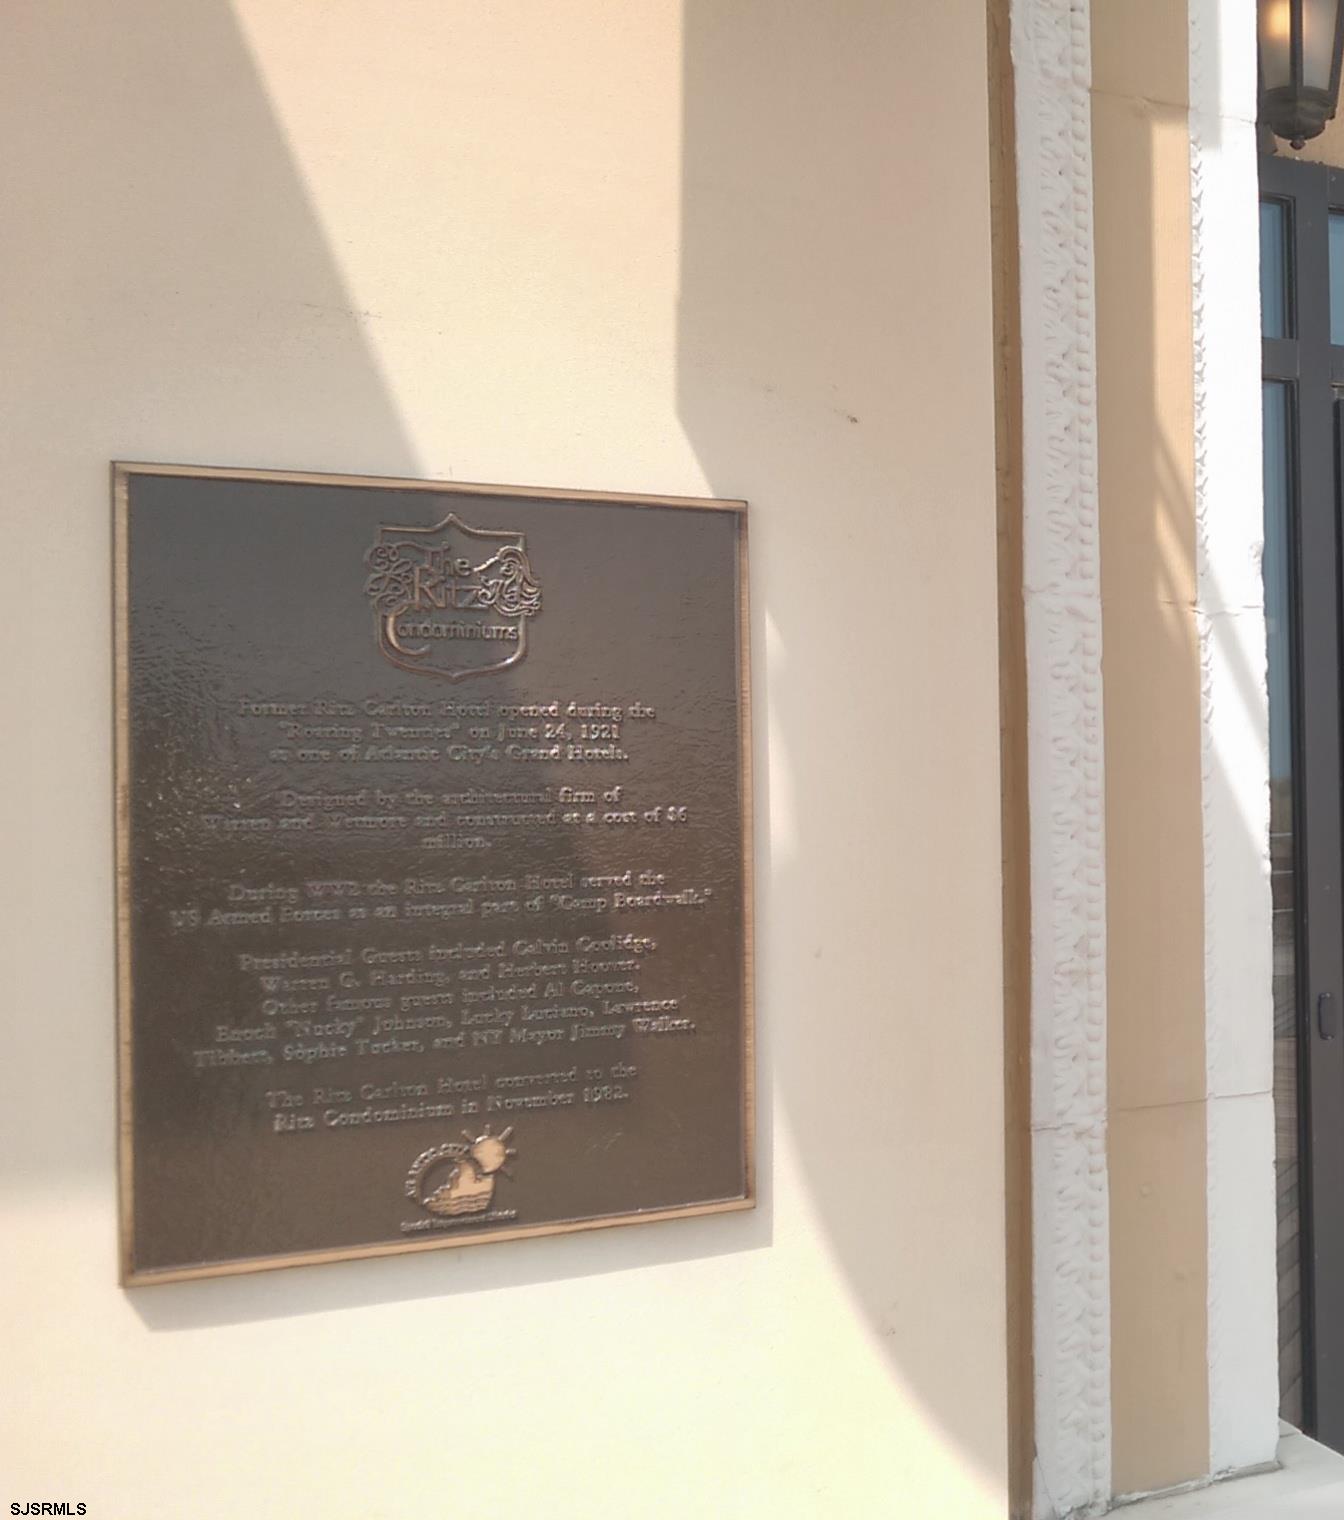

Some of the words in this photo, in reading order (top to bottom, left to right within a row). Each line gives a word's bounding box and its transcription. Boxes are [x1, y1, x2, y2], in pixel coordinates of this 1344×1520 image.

[424, 541, 471, 577] The
[440, 701, 489, 718] Hotel
[500, 701, 560, 720] opened
[567, 701, 622, 721] during
[628, 702, 656, 718] the
[469, 726, 490, 739] on
[497, 725, 539, 741] June
[545, 723, 573, 741] 24,
[581, 723, 621, 739] 1921
[299, 750, 331, 762] one
[338, 745, 360, 762] of
[506, 745, 562, 761] Grand
[567, 745, 630, 760] Hotels.
[405, 789, 434, 804] the
[559, 786, 595, 802] firm
[604, 785, 623, 802] of
[585, 812, 595, 824] a
[602, 811, 637, 824] cost
[644, 805, 663, 823] of
[666, 806, 688, 823] $6
[366, 879, 399, 896] the
[524, 873, 574, 890] Hotel
[639, 869, 665, 885] the
[526, 895, 545, 912] of
[512, 939, 569, 955] Calvin
[458, 963, 491, 980] and
[498, 961, 568, 979] Herbert
[544, 982, 564, 999] Al
[461, 1008, 515, 1027] Lucky
[284, 1043, 349, 1063] Sophie
[432, 1031, 466, 1048] and
[471, 1029, 503, 1046] NY
[509, 1027, 565, 1045] Mayor
[570, 1023, 627, 1042] Jimmy
[265, 1089, 304, 1109] The
[360, 1081, 430, 1101] Carlton
[437, 1073, 488, 1094] Hotel
[610, 1061, 638, 1079] the
[273, 1112, 316, 1132] Ritz
[323, 1101, 455, 1127] Condominium
[461, 1099, 479, 1114] in
[487, 1088, 576, 1112] November
